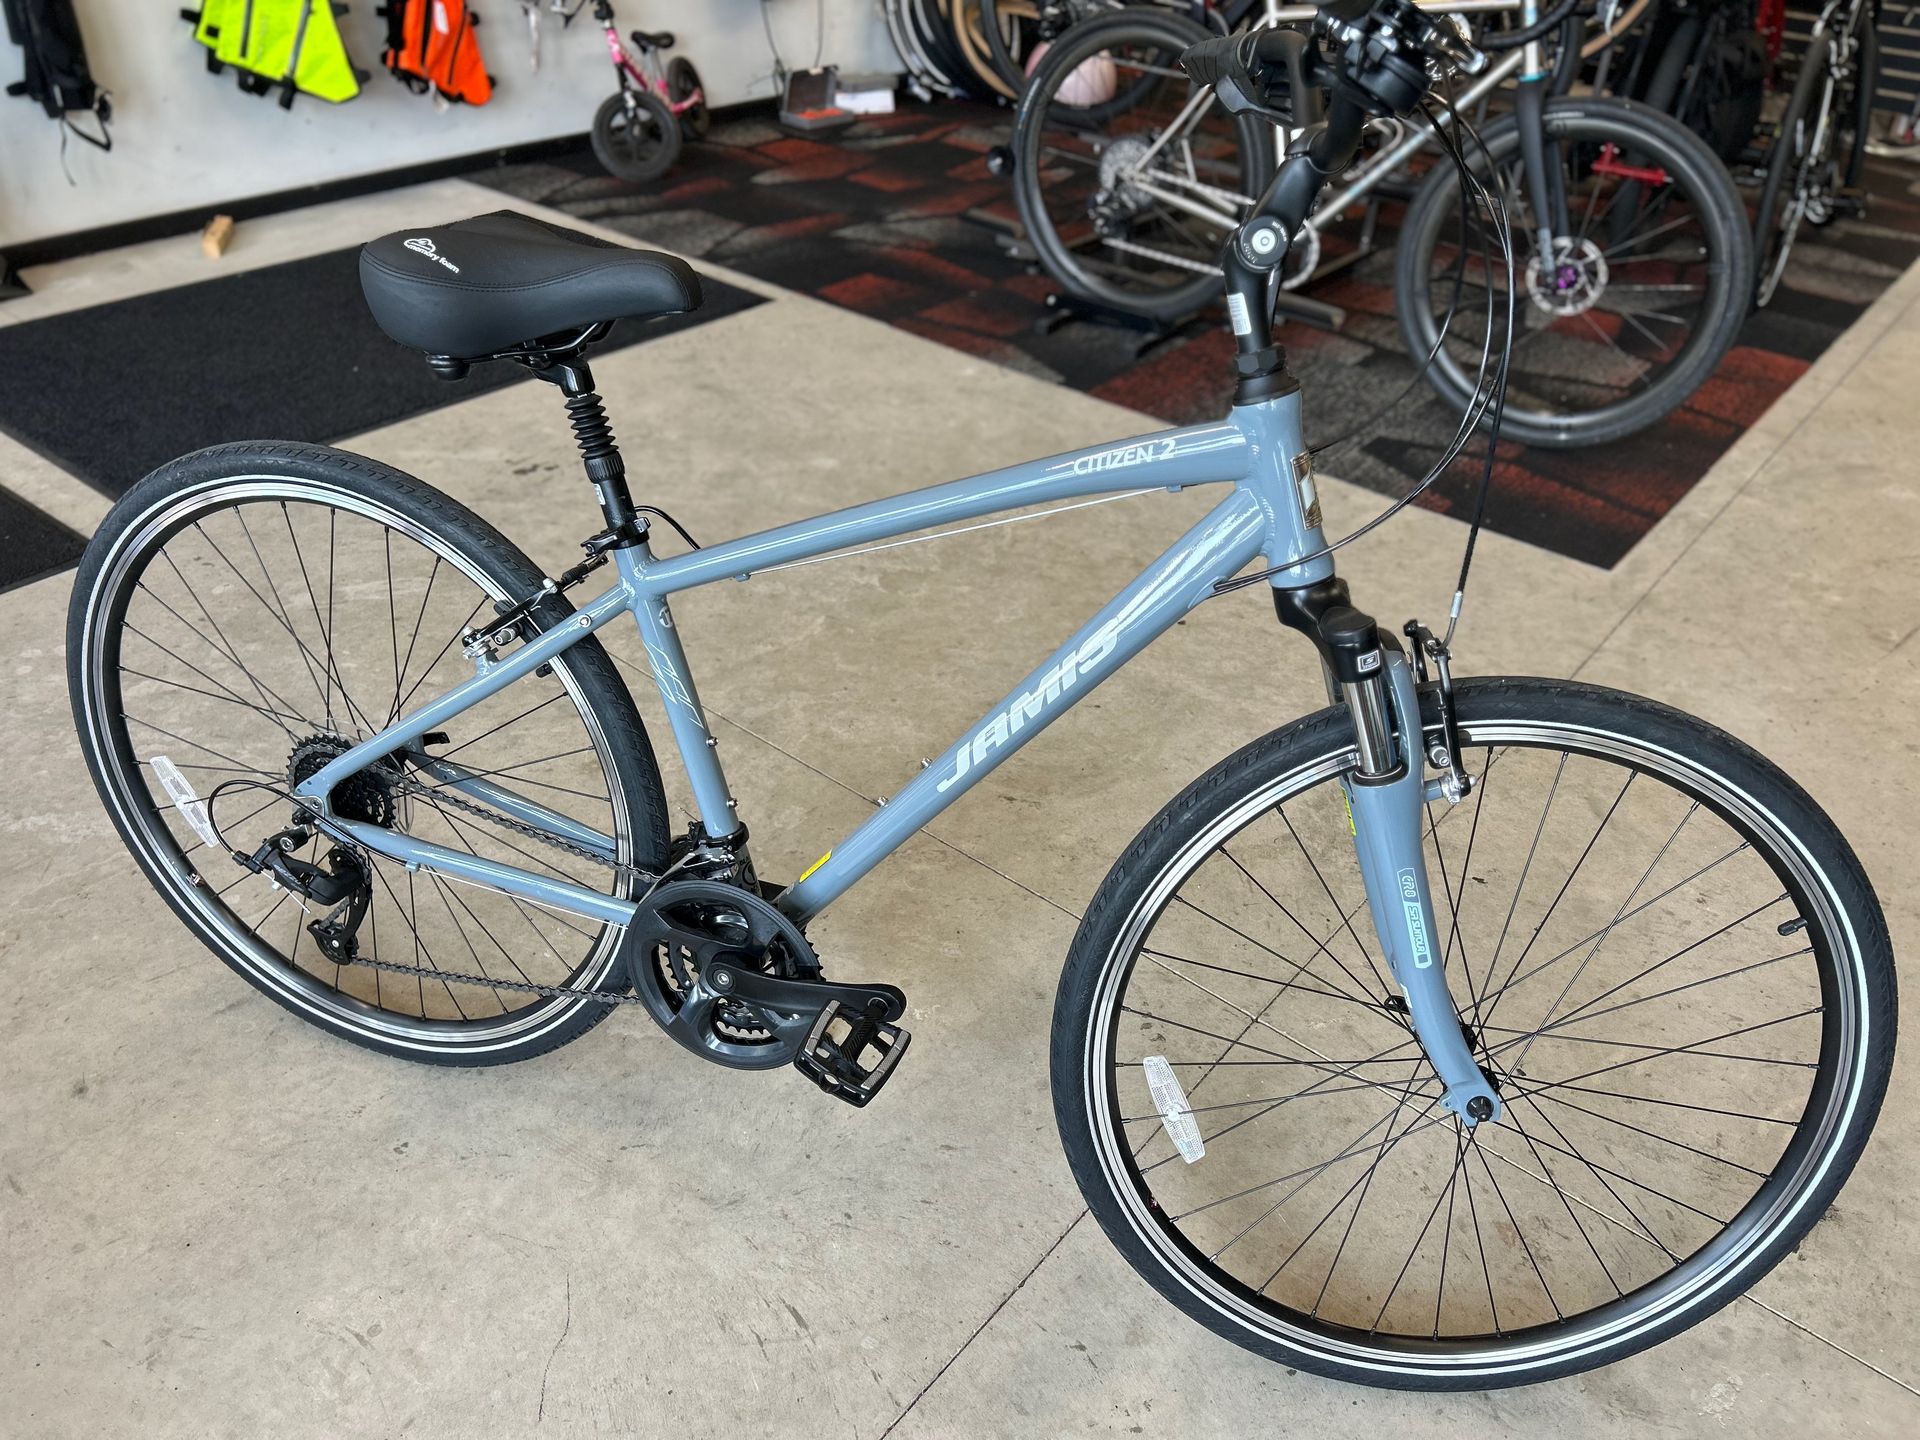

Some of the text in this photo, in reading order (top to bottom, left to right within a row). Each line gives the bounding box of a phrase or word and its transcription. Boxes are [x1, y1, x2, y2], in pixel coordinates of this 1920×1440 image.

[406, 244, 460, 274] memory foam
[1073, 439, 1177, 476] CITIZEN 2
[936, 617, 1120, 793] JAMIS
